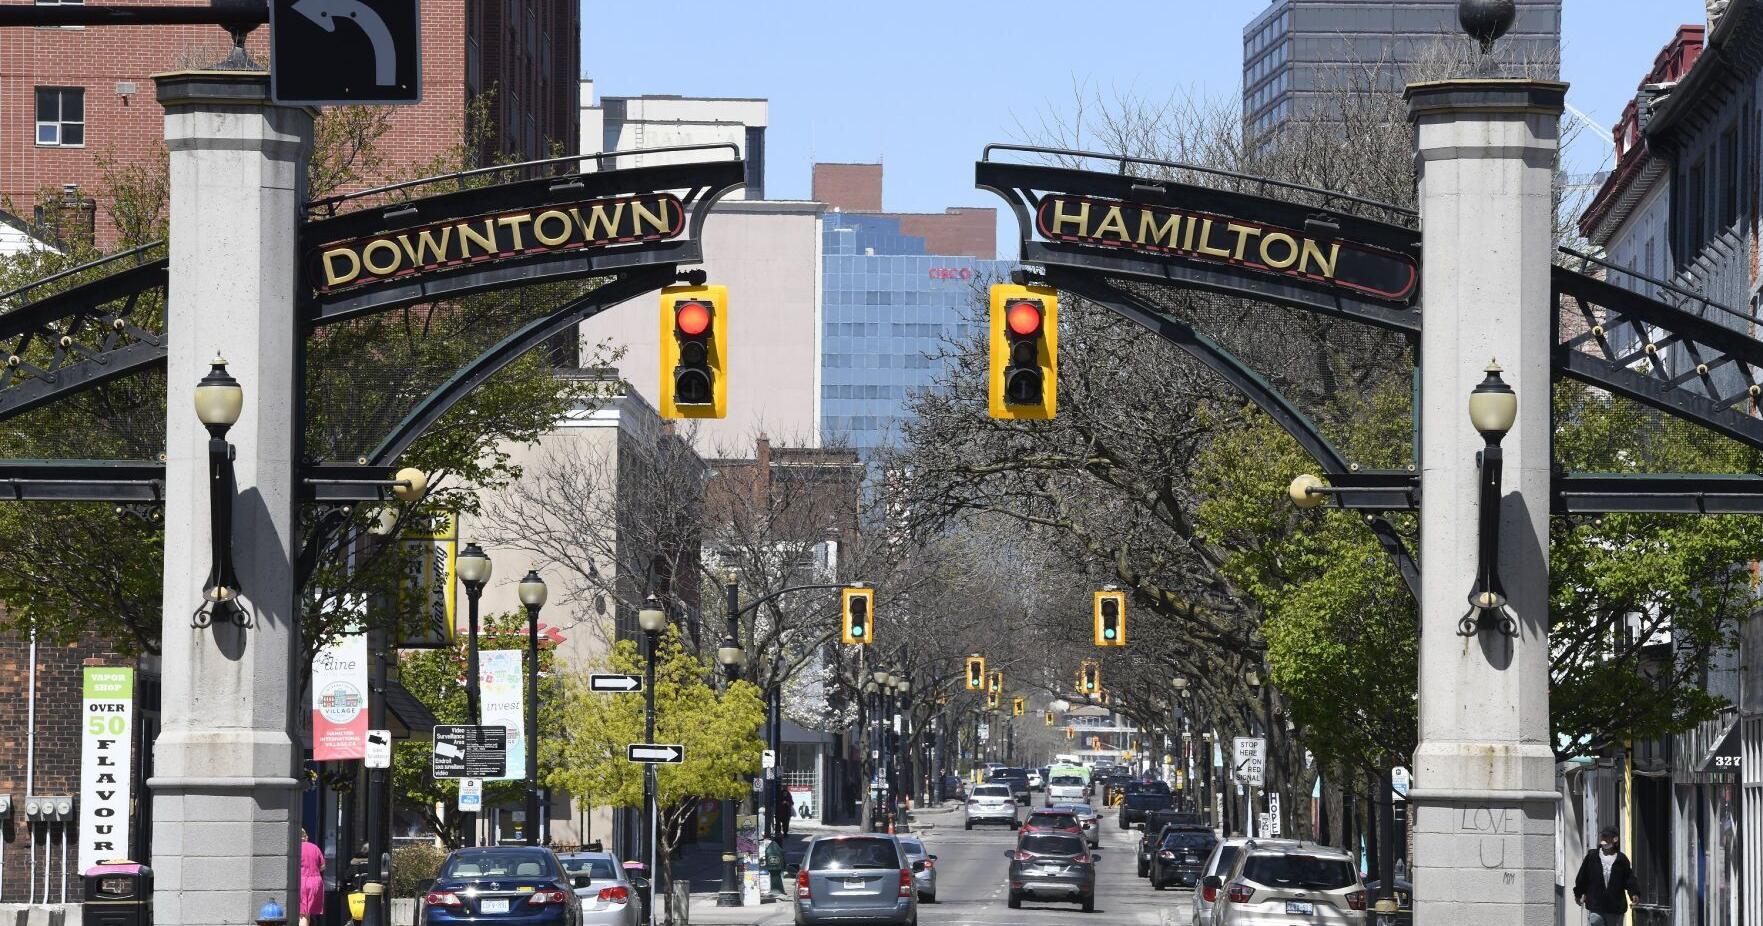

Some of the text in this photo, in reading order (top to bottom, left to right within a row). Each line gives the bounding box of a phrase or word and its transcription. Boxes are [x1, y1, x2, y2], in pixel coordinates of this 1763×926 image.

[322, 199, 671, 286] DOWNTOWN
[1052, 200, 1341, 278] HAMILTON
[325, 659, 357, 671] dine
[89, 704, 125, 712] OVER
[486, 701, 520, 712] invest
[89, 715, 126, 735] 50
[1715, 756, 1742, 766] 327
[1270, 793, 1279, 834] HOPE
[1462, 804, 1519, 833] LOVE
[1480, 838, 1505, 870] U
